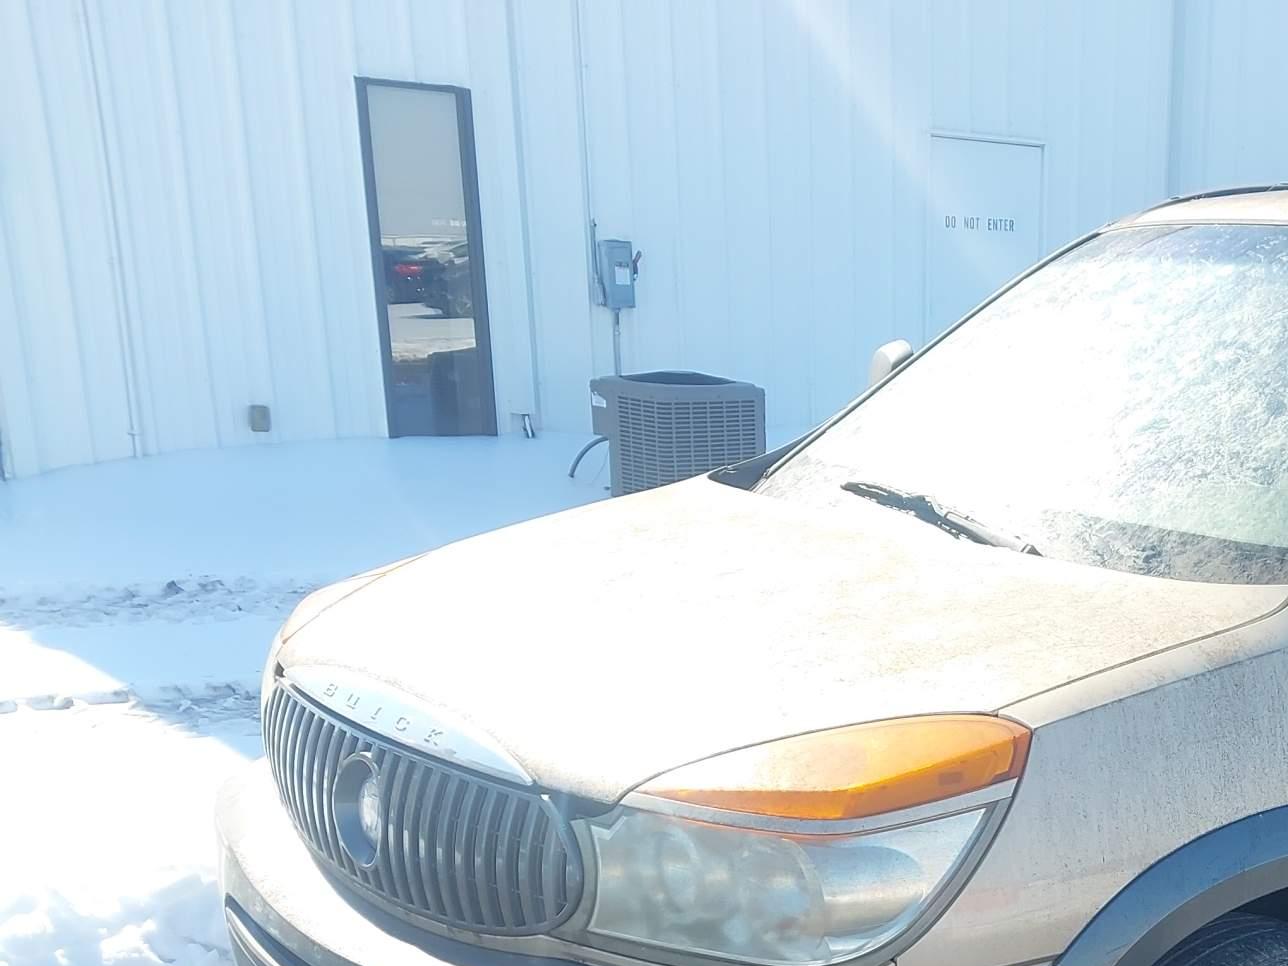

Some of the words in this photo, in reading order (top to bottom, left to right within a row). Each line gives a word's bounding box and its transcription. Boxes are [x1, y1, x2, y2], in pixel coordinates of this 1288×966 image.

[944, 215, 957, 229] DO
[963, 216, 980, 230] NOT
[987, 218, 1015, 232] ENTER
[323, 683, 444, 746] BUICK
